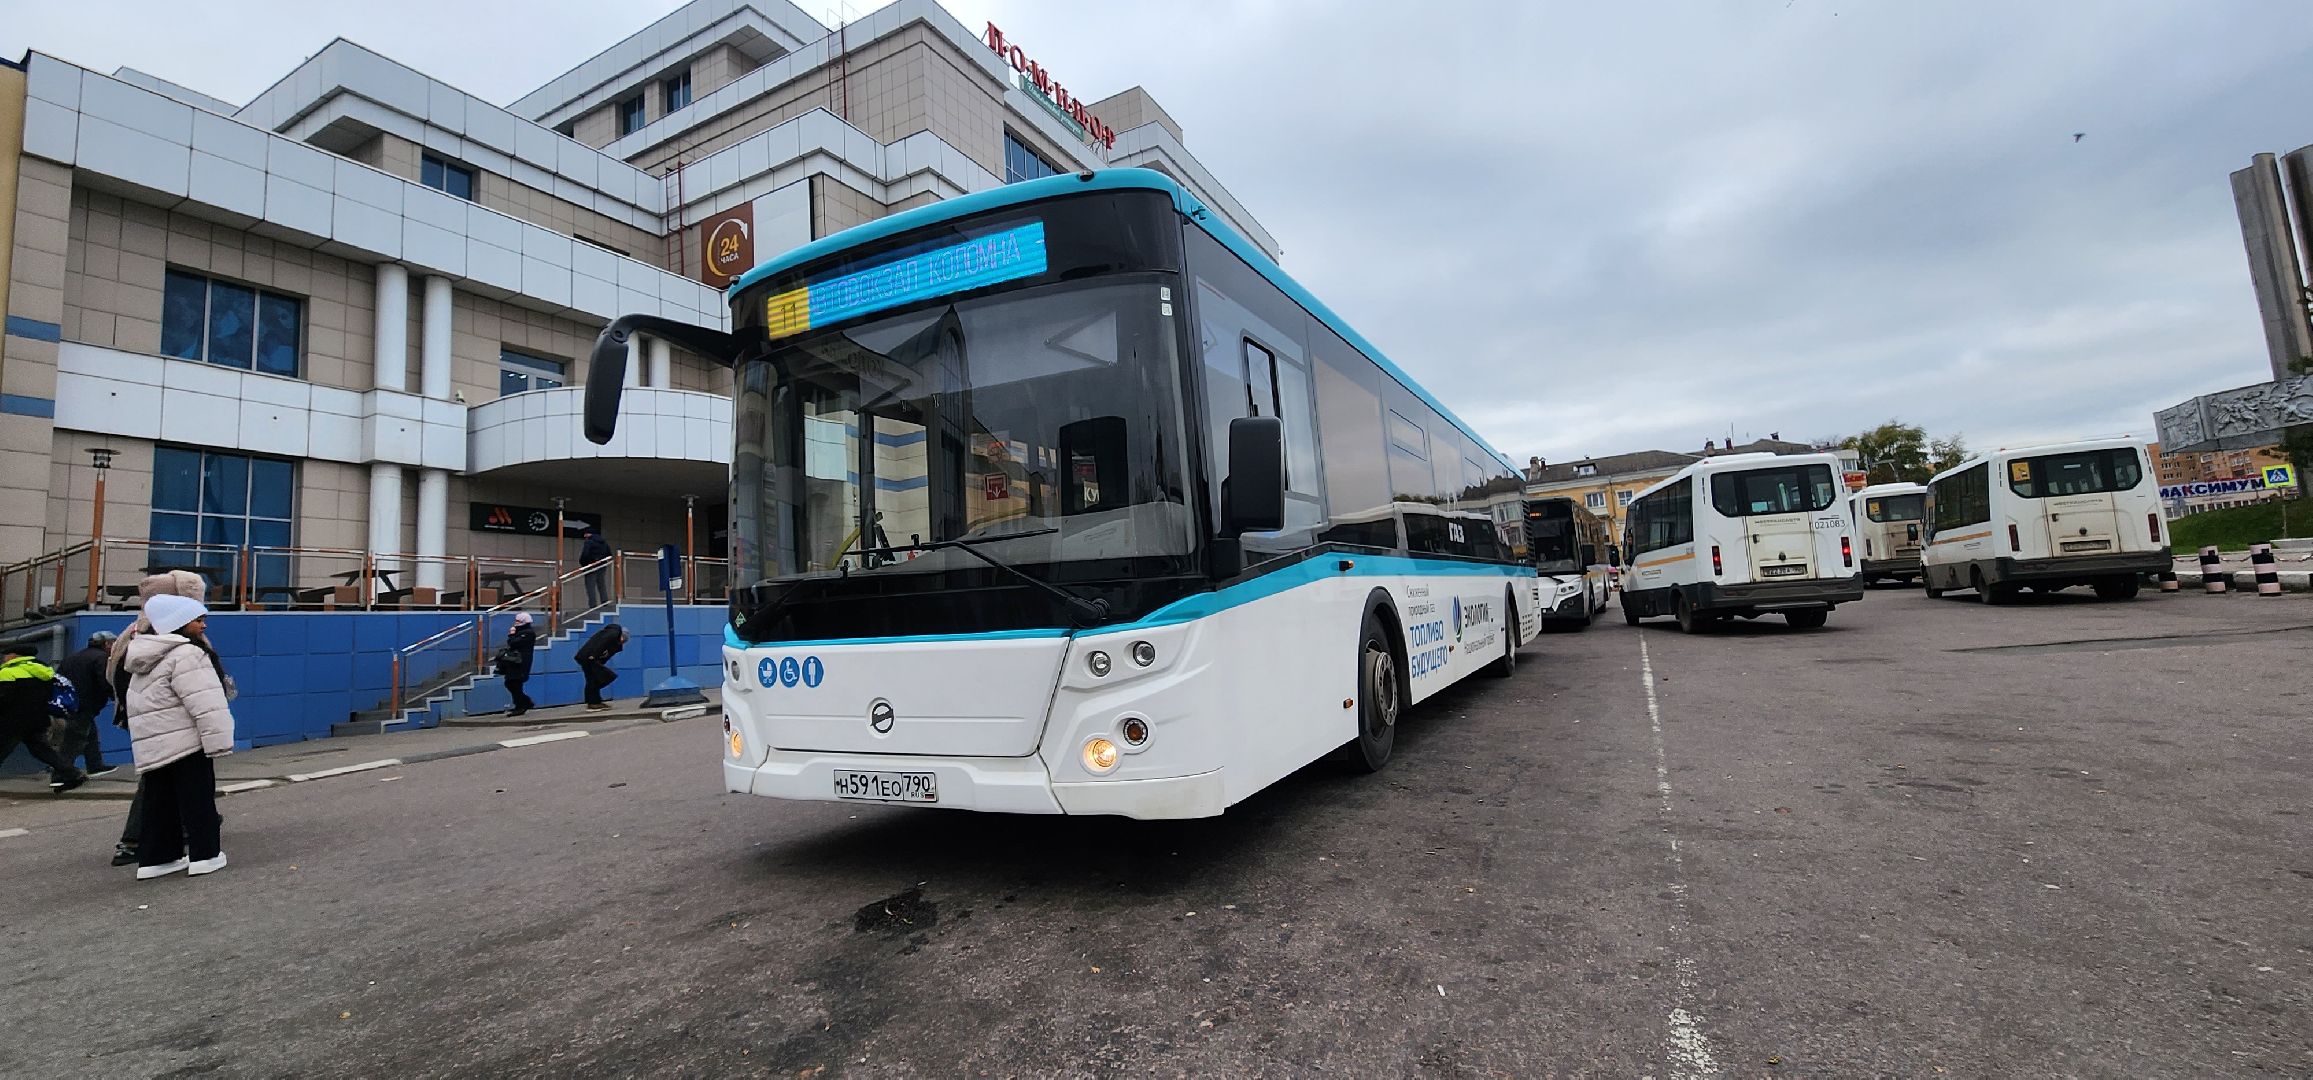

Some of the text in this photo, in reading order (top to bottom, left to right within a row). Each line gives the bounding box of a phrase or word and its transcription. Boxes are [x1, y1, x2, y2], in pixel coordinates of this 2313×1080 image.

[720, 234, 739, 257] 24
[720, 252, 740, 264] ЧАСА
[929, 232, 1021, 284] КОЛОМНА
[780, 301, 798, 330] 11
[1814, 519, 1846, 530] 021083
[1409, 620, 1444, 649] ТОПЛИВО
[1411, 646, 1448, 680] БУДУЩЕГО
[903, 775, 930, 793] 790
